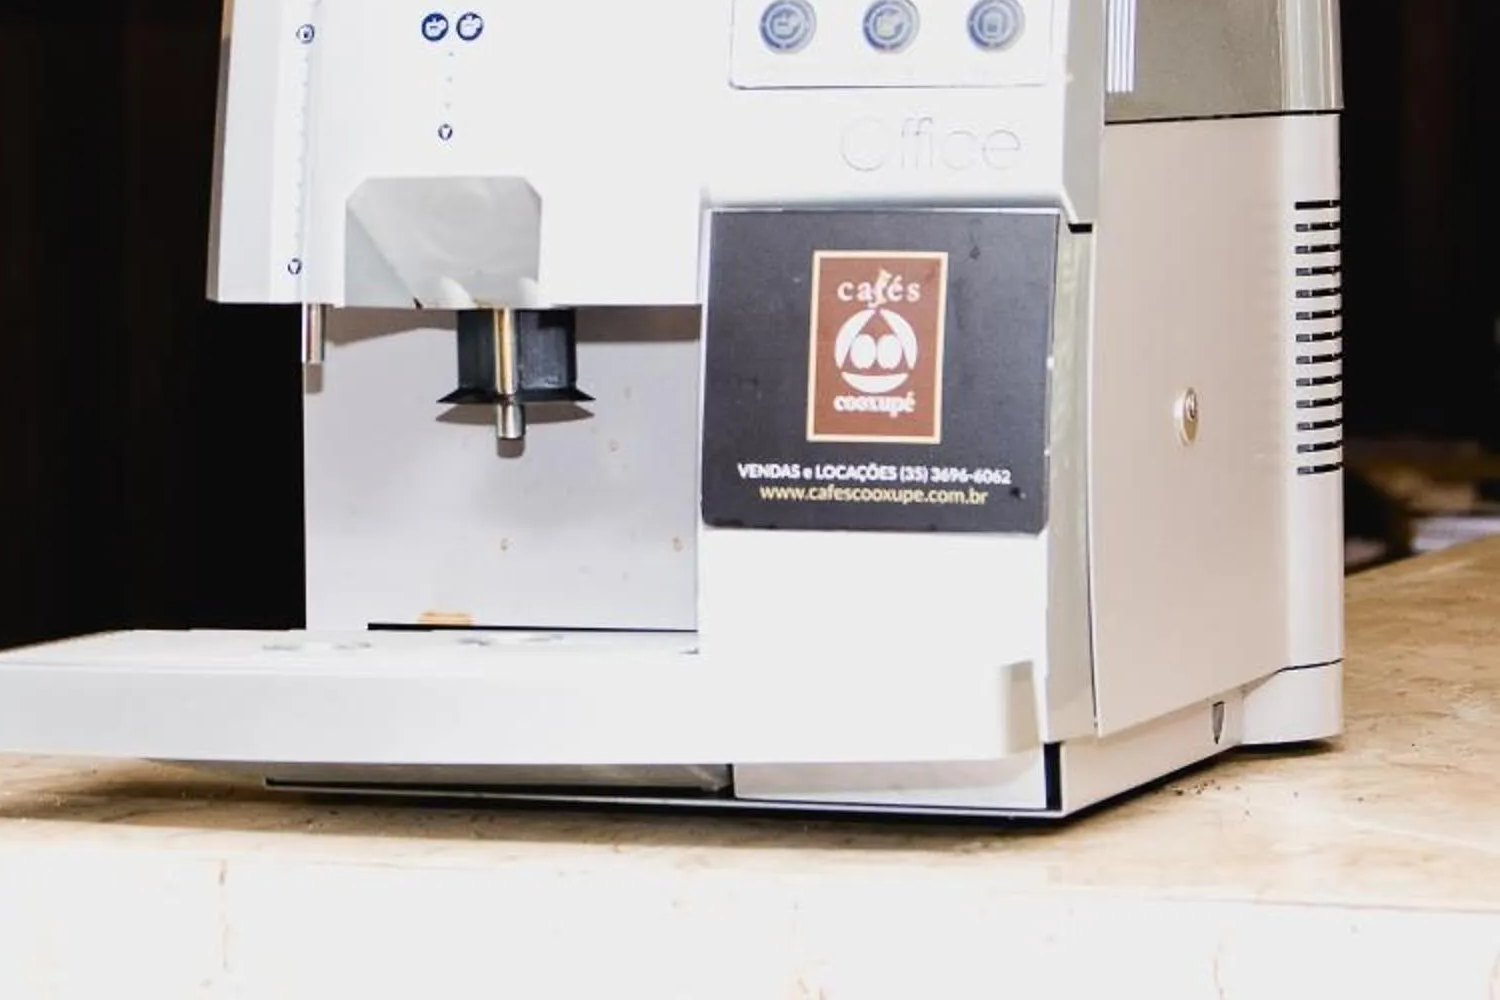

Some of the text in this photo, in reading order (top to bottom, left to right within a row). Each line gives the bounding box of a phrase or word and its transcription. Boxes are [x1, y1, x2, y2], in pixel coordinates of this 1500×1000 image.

[837, 269, 921, 308] cafés
[737, 462, 801, 480] VENDAS
[803, 466, 813, 480] e
[815, 461, 898, 482] LOCAÇÕES
[759, 484, 989, 505] www.cafescooxupe.com.br
